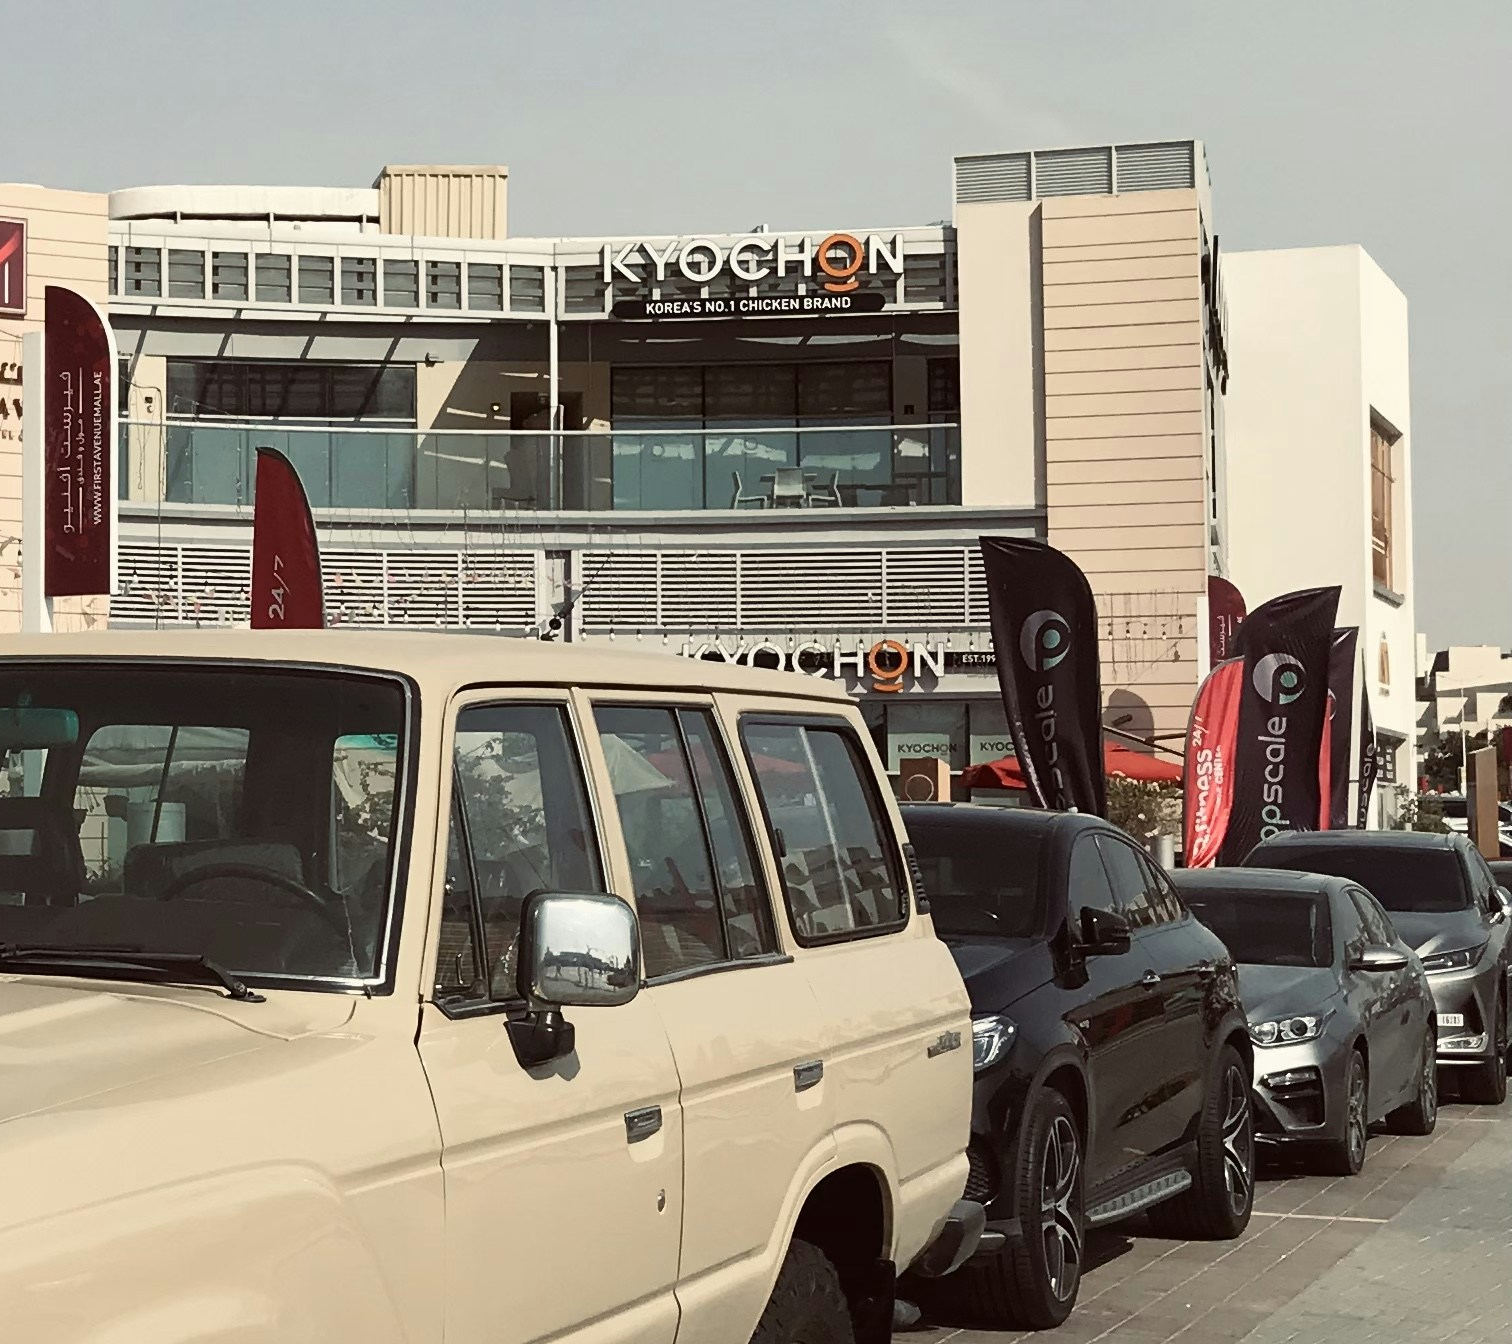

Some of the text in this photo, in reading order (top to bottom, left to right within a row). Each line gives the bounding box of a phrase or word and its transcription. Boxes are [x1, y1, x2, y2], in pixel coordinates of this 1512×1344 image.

[603, 233, 904, 293] KYOCHON
[645, 296, 851, 315] KOREA'S NO.1 CHICKEN BRAND
[268, 554, 291, 620] 24/7
[897, 742, 958, 756] KYOCHON
